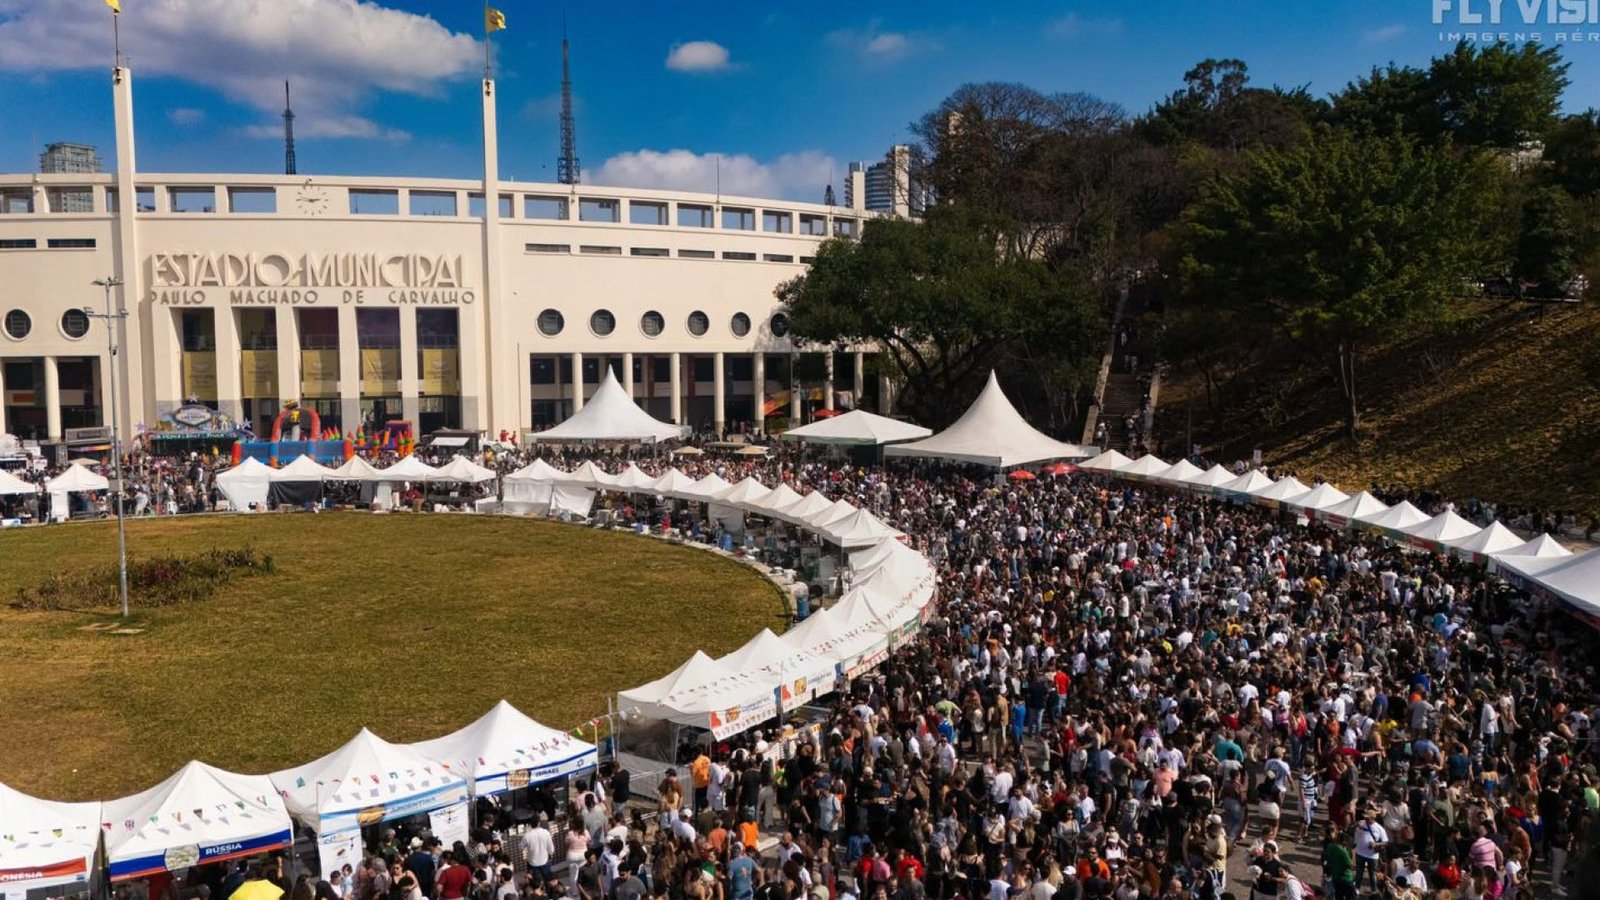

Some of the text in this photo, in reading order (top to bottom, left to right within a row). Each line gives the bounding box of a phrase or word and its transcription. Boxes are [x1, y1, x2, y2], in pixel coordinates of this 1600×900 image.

[151, 290, 475, 305] PAULO MACHADO DE CARVALHO
